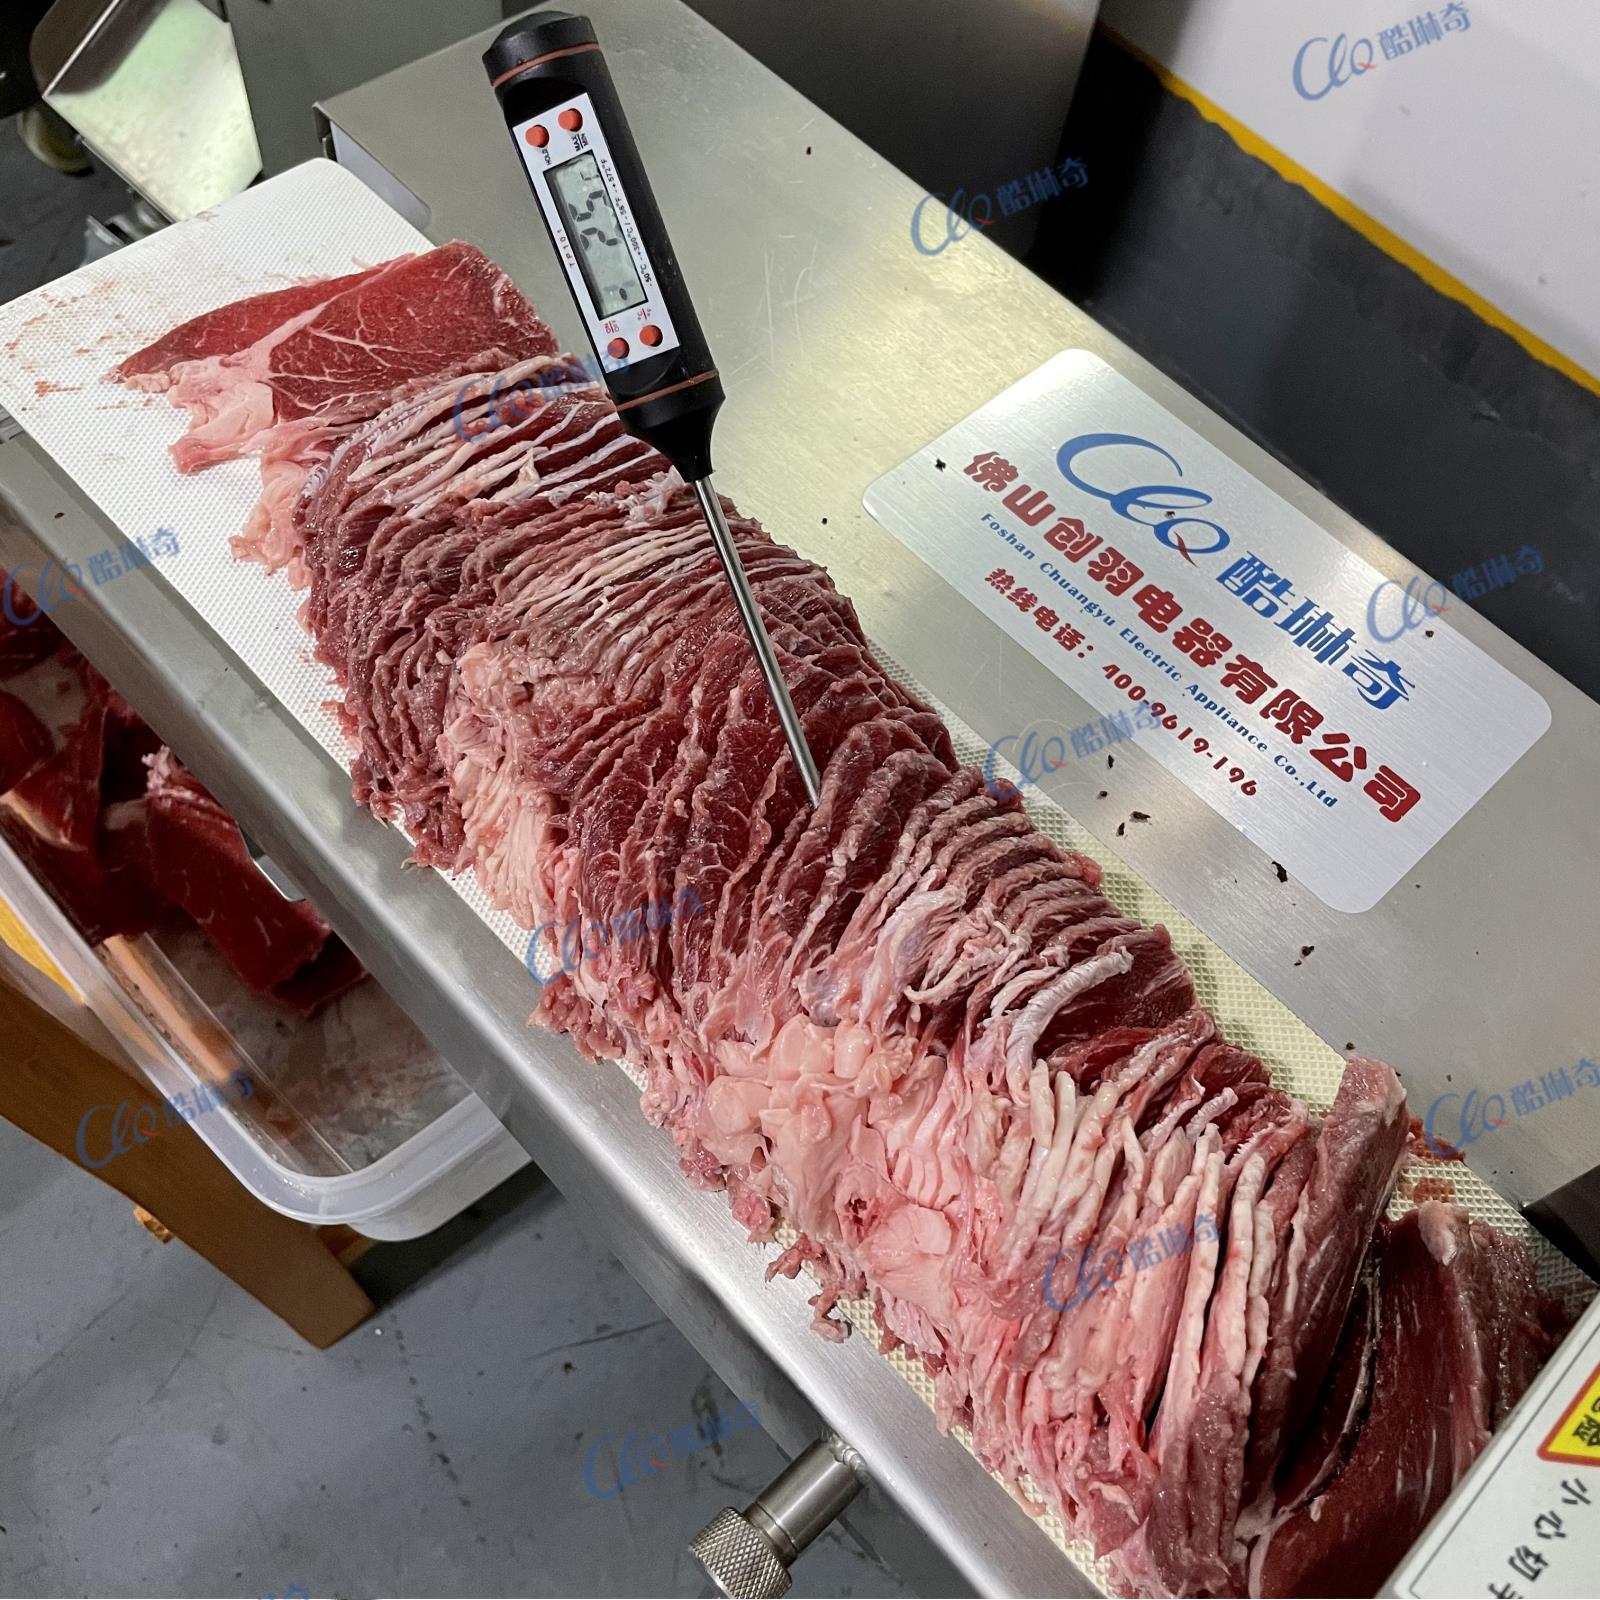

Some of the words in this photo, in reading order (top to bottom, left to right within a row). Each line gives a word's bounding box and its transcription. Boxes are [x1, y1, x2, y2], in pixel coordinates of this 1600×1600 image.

[963, 451, 1421, 822] 佛山创羽电器有限公司
[981, 512, 1036, 561] Foshan
[1039, 562, 1116, 627] Chuangyu
[1119, 627, 1183, 682] Electric
[1185, 683, 1268, 752] Appliance
[1273, 754, 1338, 808] Co.,Ltd
[1102, 664, 1258, 796] 400-9619-196
[1216, 550, 1416, 711] 酷琳奇
